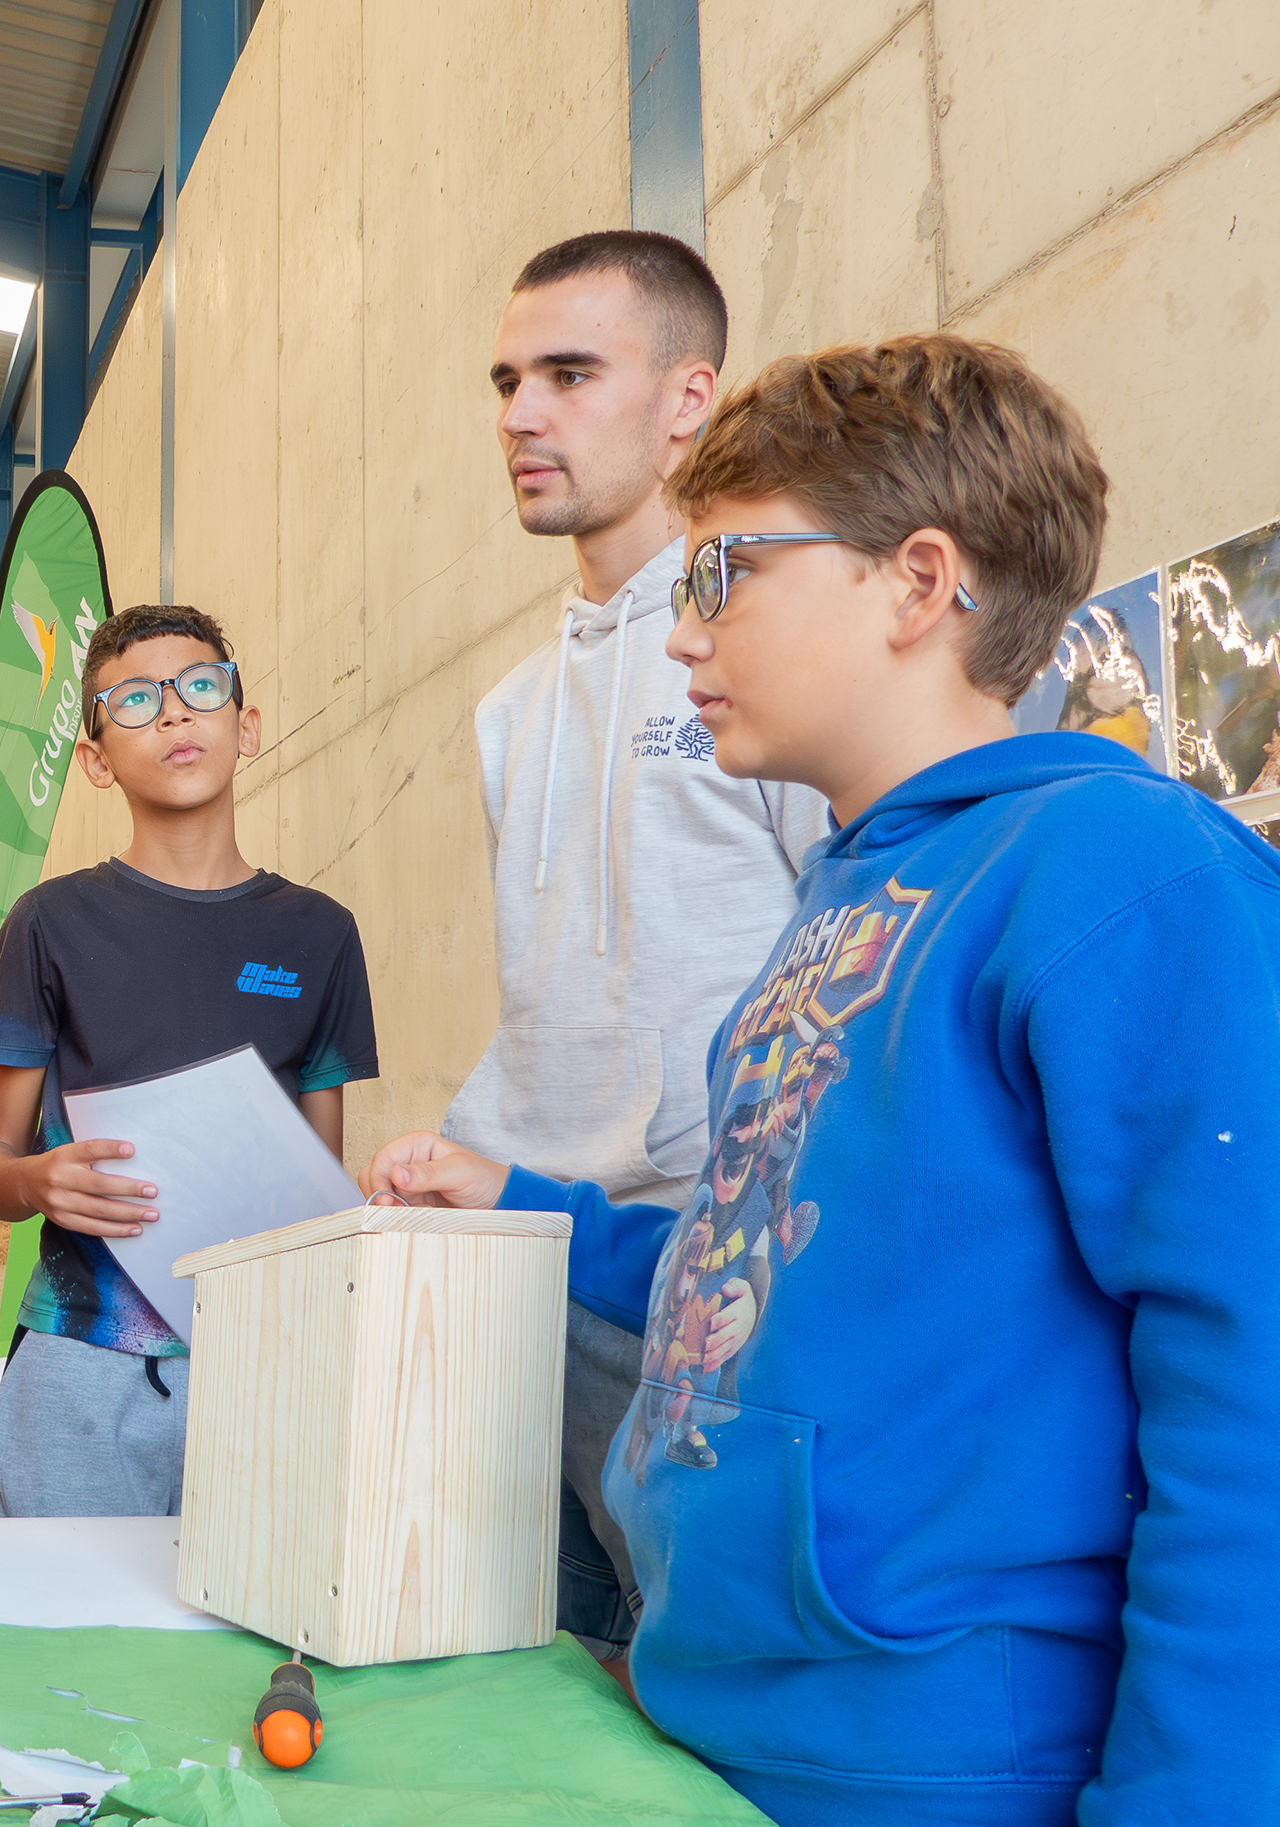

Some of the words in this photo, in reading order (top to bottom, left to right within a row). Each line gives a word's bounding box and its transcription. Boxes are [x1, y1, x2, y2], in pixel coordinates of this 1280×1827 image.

[644, 716, 676, 728] ALLOW
[29, 679, 76, 807] Grupo
[630, 730, 673, 747] YOURSELF
[631, 747, 640, 759] TO
[641, 744, 670, 757] GROW
[763, 904, 851, 988] LASH
[240, 961, 299, 984] Make
[236, 975, 303, 999] Waves
